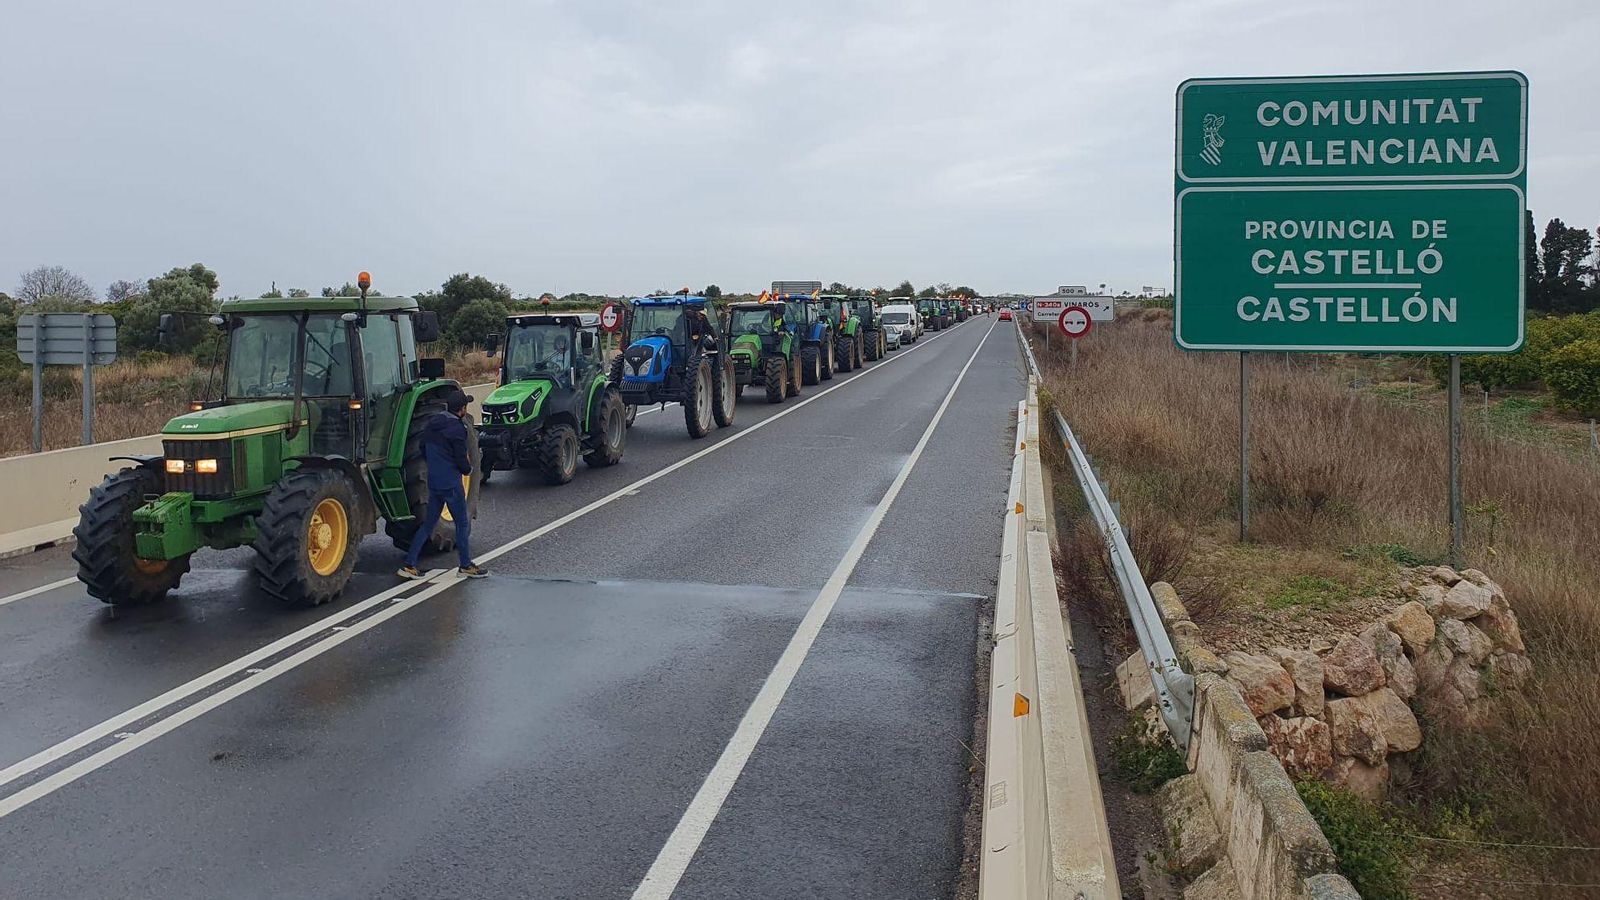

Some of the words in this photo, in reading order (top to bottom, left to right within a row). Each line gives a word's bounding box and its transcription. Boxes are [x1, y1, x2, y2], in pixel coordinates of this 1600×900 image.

[1256, 97, 1483, 126] COMUNITAT
[1257, 137, 1500, 166] VALENCIANA
[1245, 220, 1395, 240] PROVINCIA
[1411, 219, 1448, 239] DE
[1251, 242, 1443, 275] CASTELLÓ
[1236, 292, 1457, 323] CASTELLÓN
